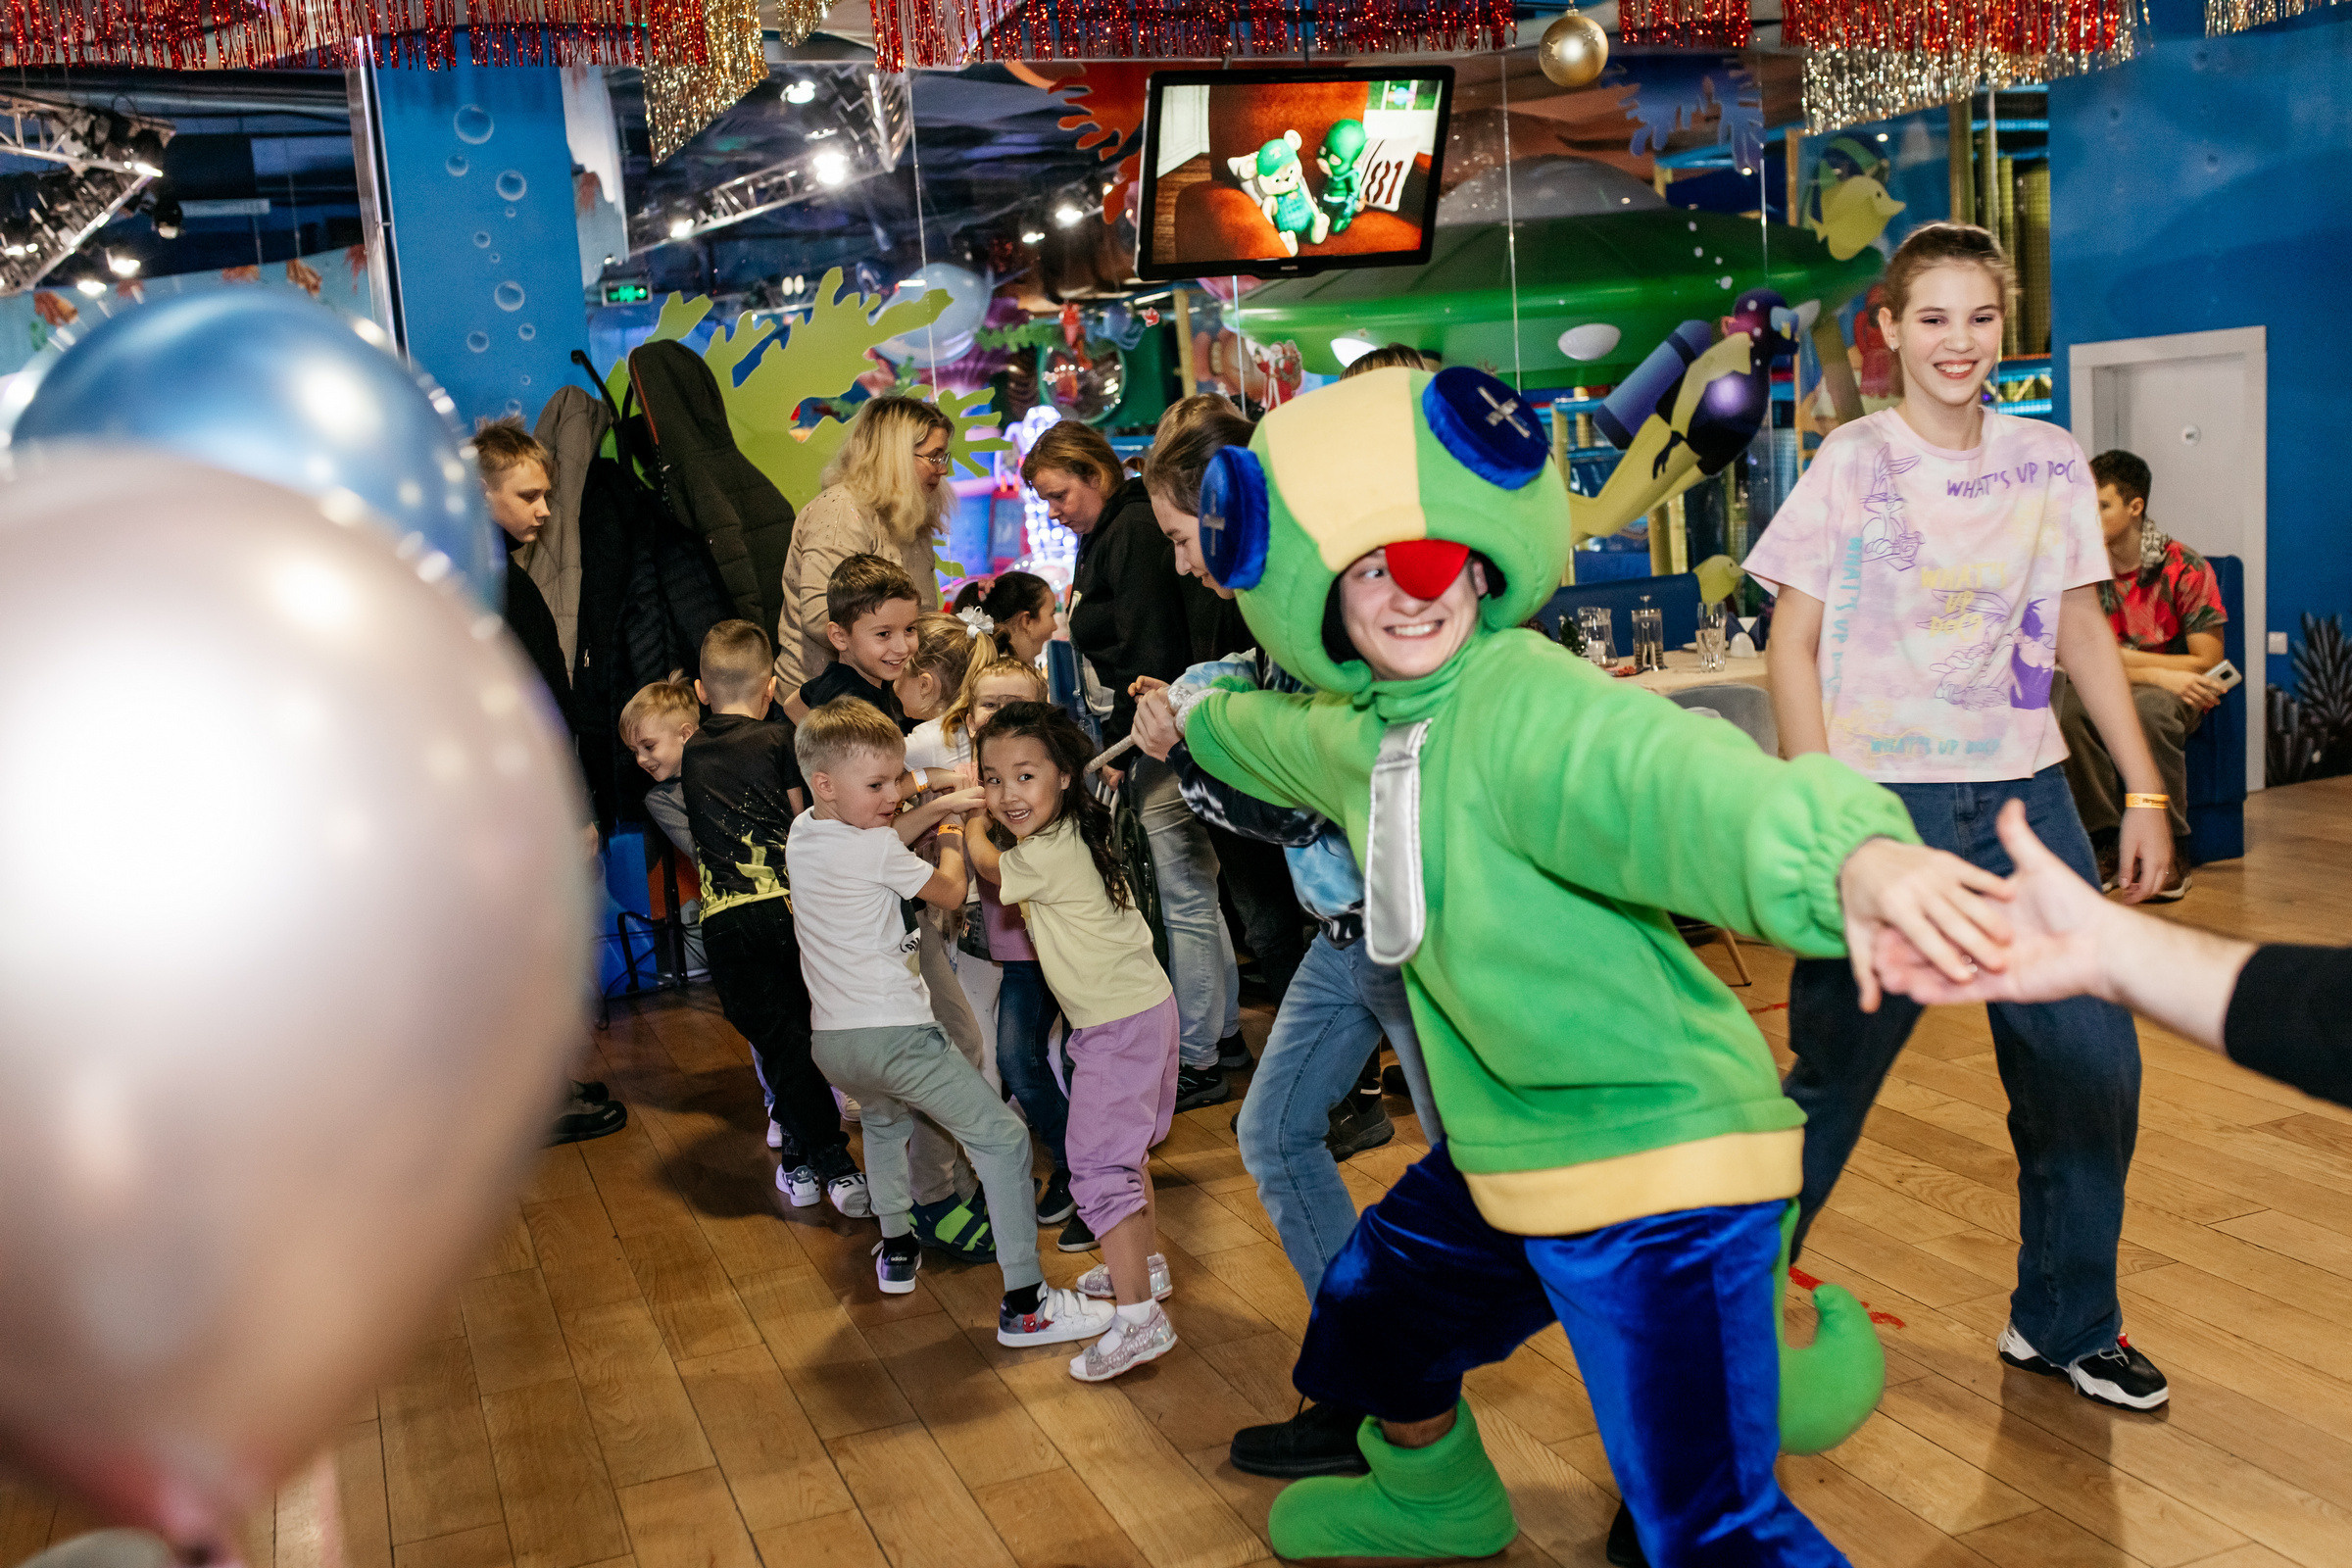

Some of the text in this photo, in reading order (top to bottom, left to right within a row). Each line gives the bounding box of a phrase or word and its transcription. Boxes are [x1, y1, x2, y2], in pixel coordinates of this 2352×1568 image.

[1946, 470, 2011, 499] WHAT'S
[2016, 462, 2038, 484] UP
[1835, 536, 1863, 612] WHAT'S
[1921, 562, 2008, 590] WHAT'S
[1944, 590, 1976, 614] UP
[1831, 618, 1850, 644] UP
